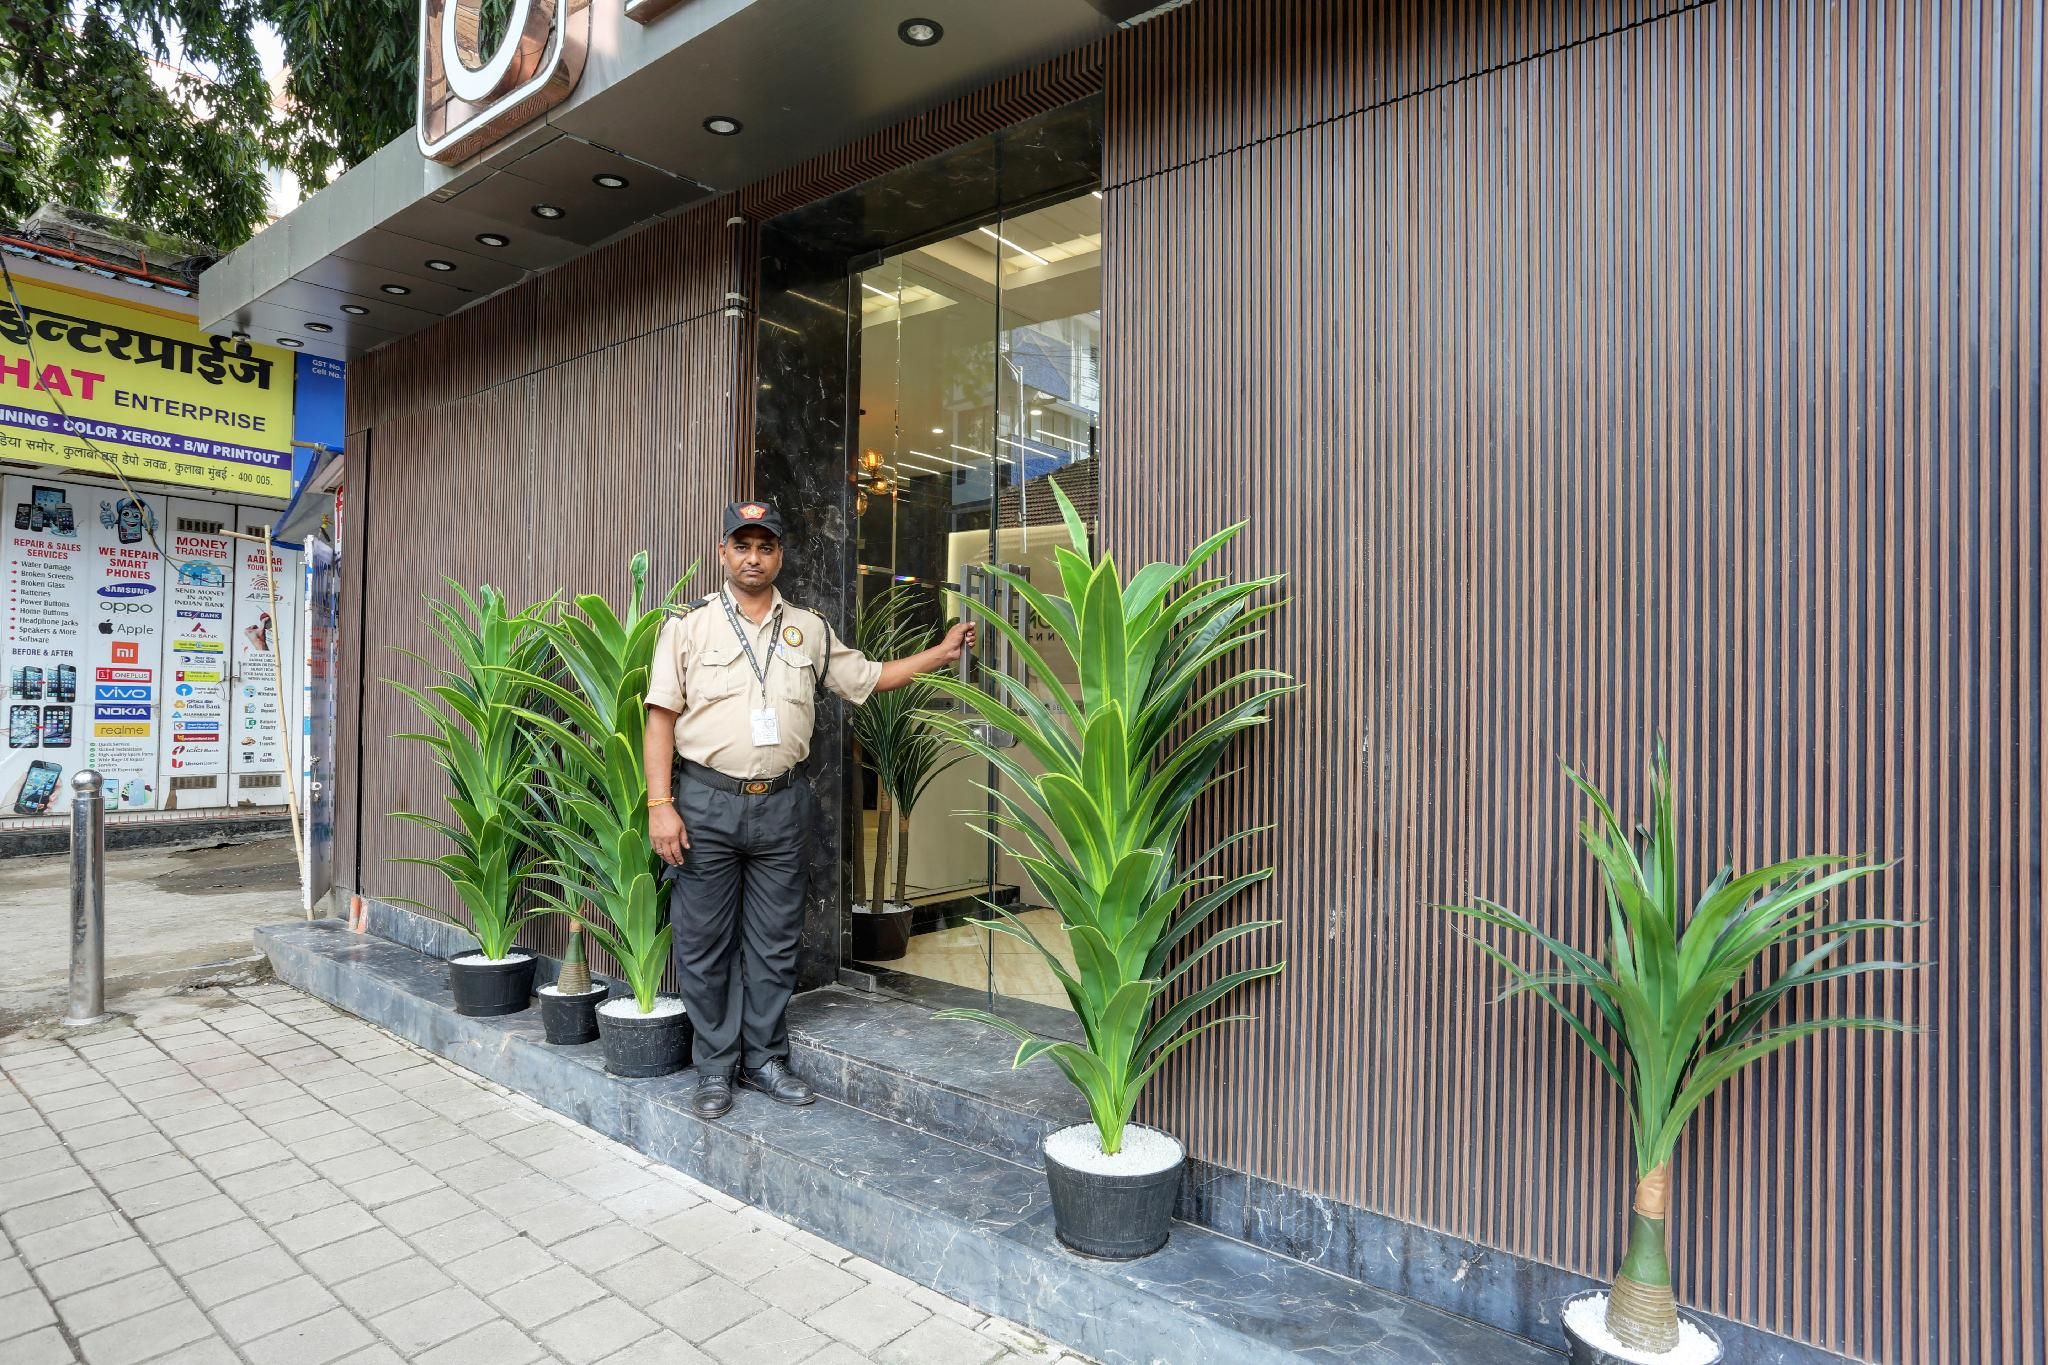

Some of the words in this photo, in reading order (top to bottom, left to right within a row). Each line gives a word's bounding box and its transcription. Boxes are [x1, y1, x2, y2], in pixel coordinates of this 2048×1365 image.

[312, 359, 327, 368] GST
[329, 363, 342, 372] No.
[312, 367, 327, 376] Cell
[328, 371, 342, 379] No.
[115, 389, 266, 432] ENTERPRISE
[63, 420, 118, 439] COLOR
[121, 429, 171, 448] XEROX
[184, 439, 209, 454] B/W
[213, 445, 280, 465] PRINTOUT
[238, 471, 253, 483] 400
[255, 475, 273, 486] 005.
[14, 538, 45, 549] REPAIR
[47, 541, 53, 550] &
[56, 542, 81, 552] SALES
[176, 536, 228, 549] MONEY
[27, 548, 69, 560] SERVICES
[98, 546, 116, 557] WE
[120, 548, 160, 561] REPAIR
[175, 546, 228, 559] TRANSFER
[21, 560, 42, 569] Water
[43, 562, 72, 572] Damage
[109, 558, 149, 570] SMART
[247, 564, 264, 572] YOUR
[21, 570, 46, 578] Broken
[47, 572, 74, 581] Screens
[106, 568, 152, 580] PHONES
[20, 579, 45, 588] Broken
[47, 581, 65, 589] Glass
[105, 585, 150, 595] SAMSUNG
[20, 588, 51, 597] Batteries
[20, 597, 42, 606] Power
[44, 599, 70, 608] Buttons
[43, 608, 69, 617] Buttons
[19, 616, 60, 626] Headphone
[61, 618, 79, 627] Jacks
[19, 626, 51, 634] Speakers
[59, 628, 77, 636] More
[116, 623, 154, 636] Apple
[19, 635, 50, 644] Software
[12, 647, 41, 656] BEFORE
[43, 649, 48, 657] &
[50, 649, 74, 657] AFTER
[98, 707, 148, 716] NOKIA
[100, 724, 144, 735] realme
